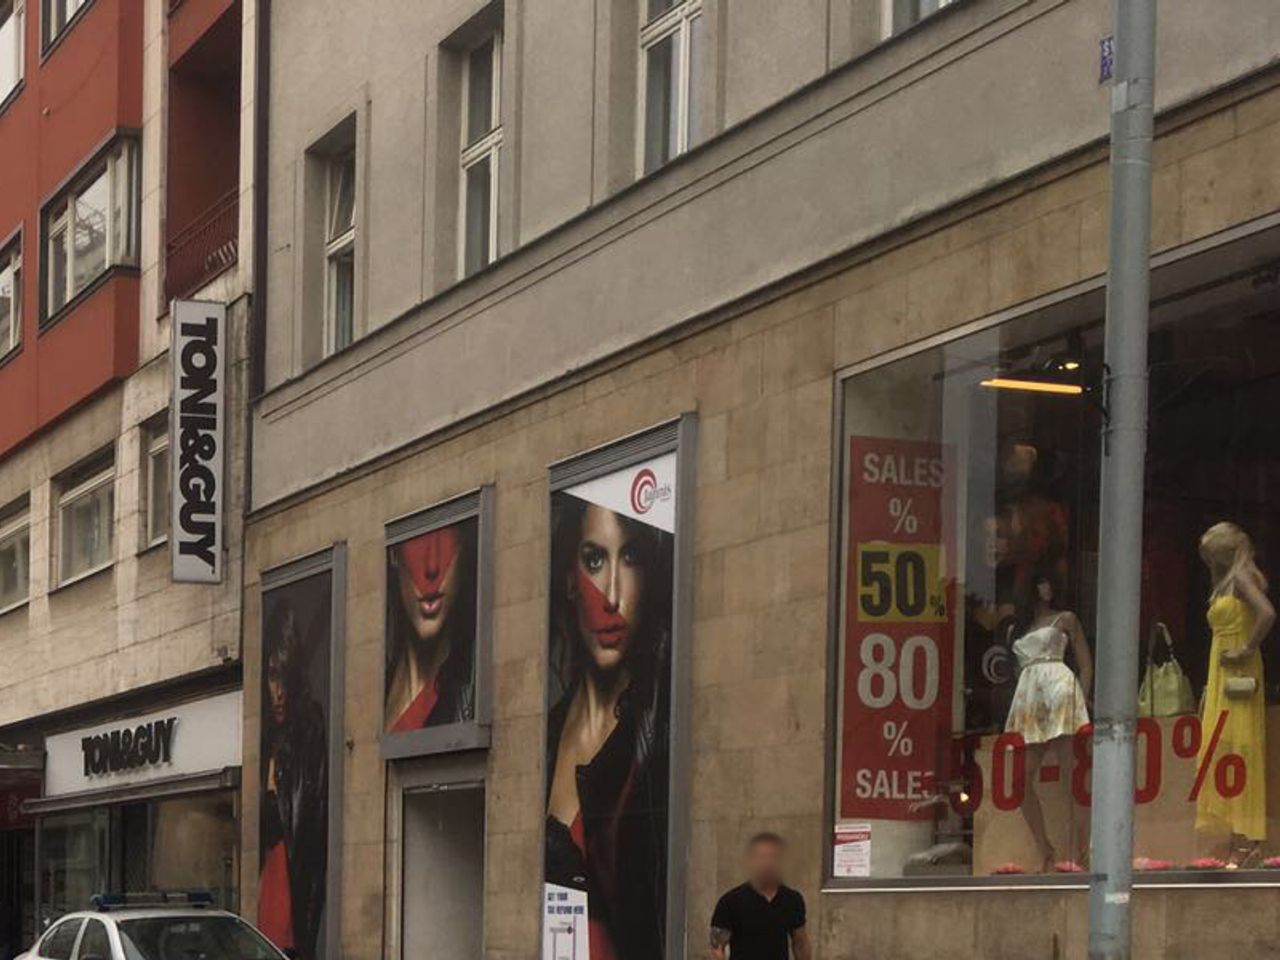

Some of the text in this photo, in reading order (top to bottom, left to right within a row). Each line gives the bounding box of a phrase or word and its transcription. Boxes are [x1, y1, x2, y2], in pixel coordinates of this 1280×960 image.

[179, 317, 218, 573] TONI&GUY
[863, 453, 946, 488] SALES
[857, 633, 940, 710] 80
[81, 716, 178, 777] TONI&GUY
